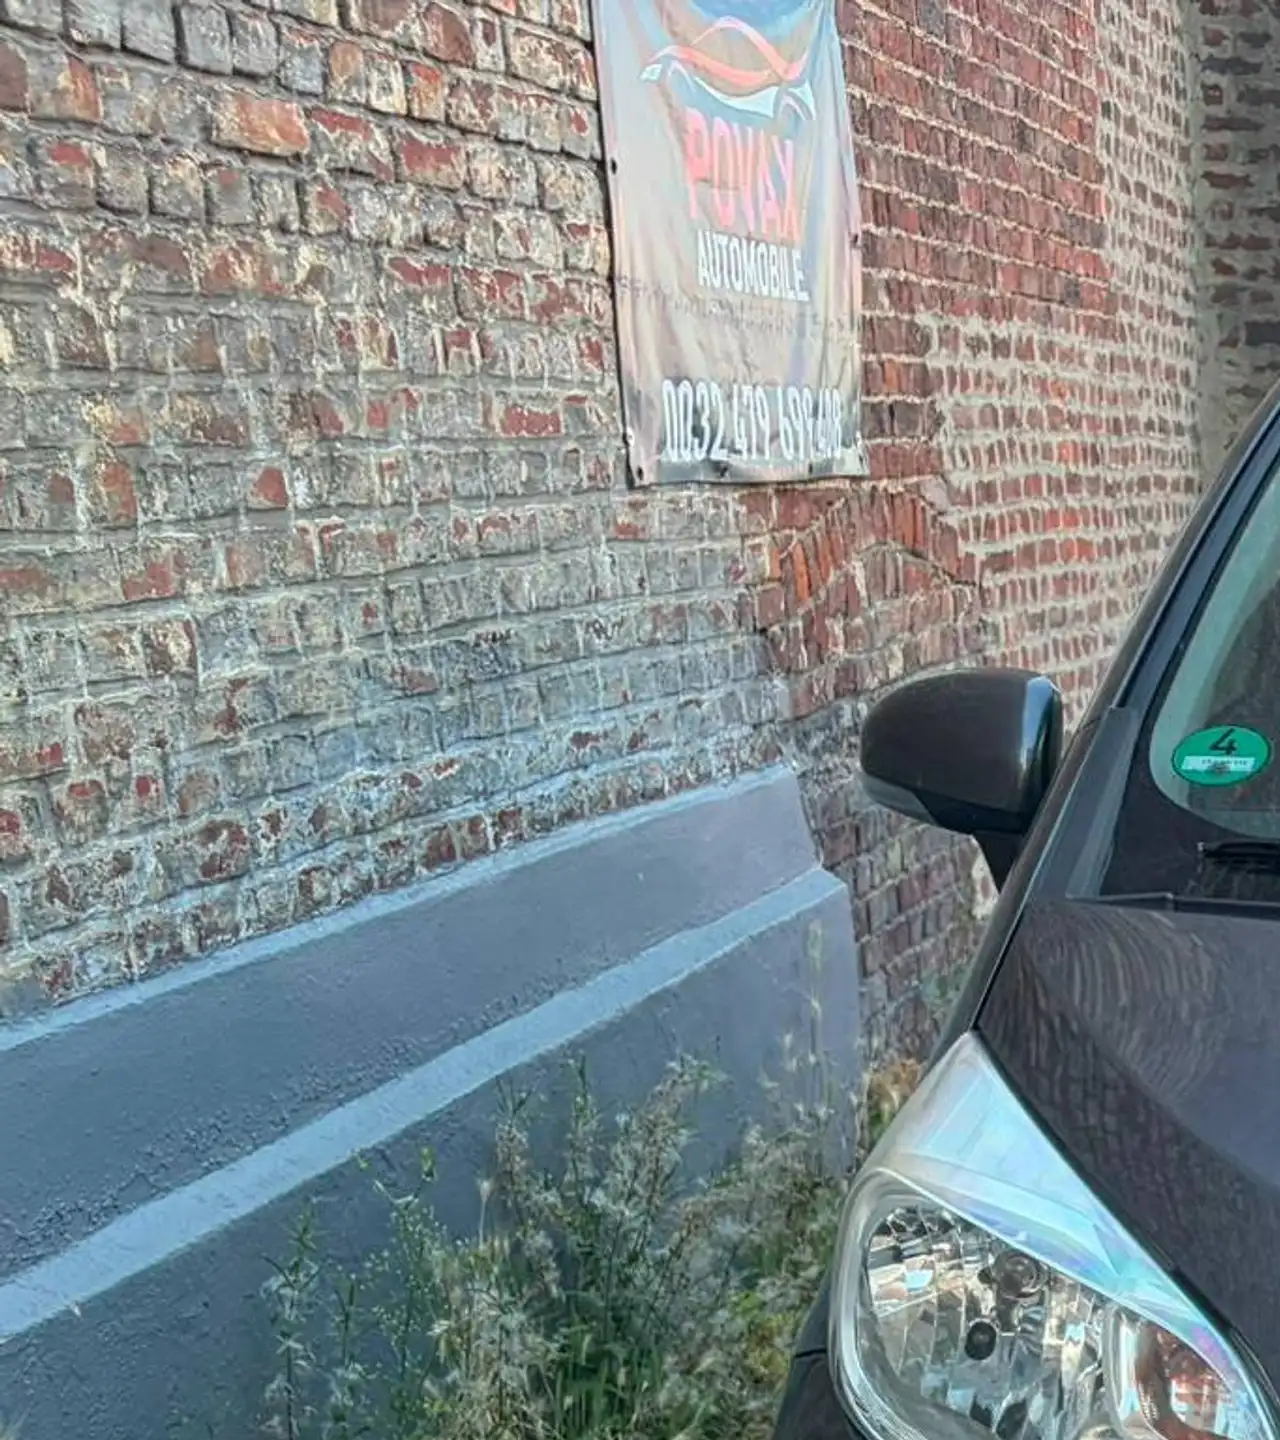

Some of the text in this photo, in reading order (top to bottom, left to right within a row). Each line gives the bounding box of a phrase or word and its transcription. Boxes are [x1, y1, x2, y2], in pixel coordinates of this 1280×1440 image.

[697, 227, 810, 301] AUTOMOBILE
[662, 379, 729, 462] 0032
[733, 384, 771, 462] 479
[1209, 728, 1237, 754] 4
